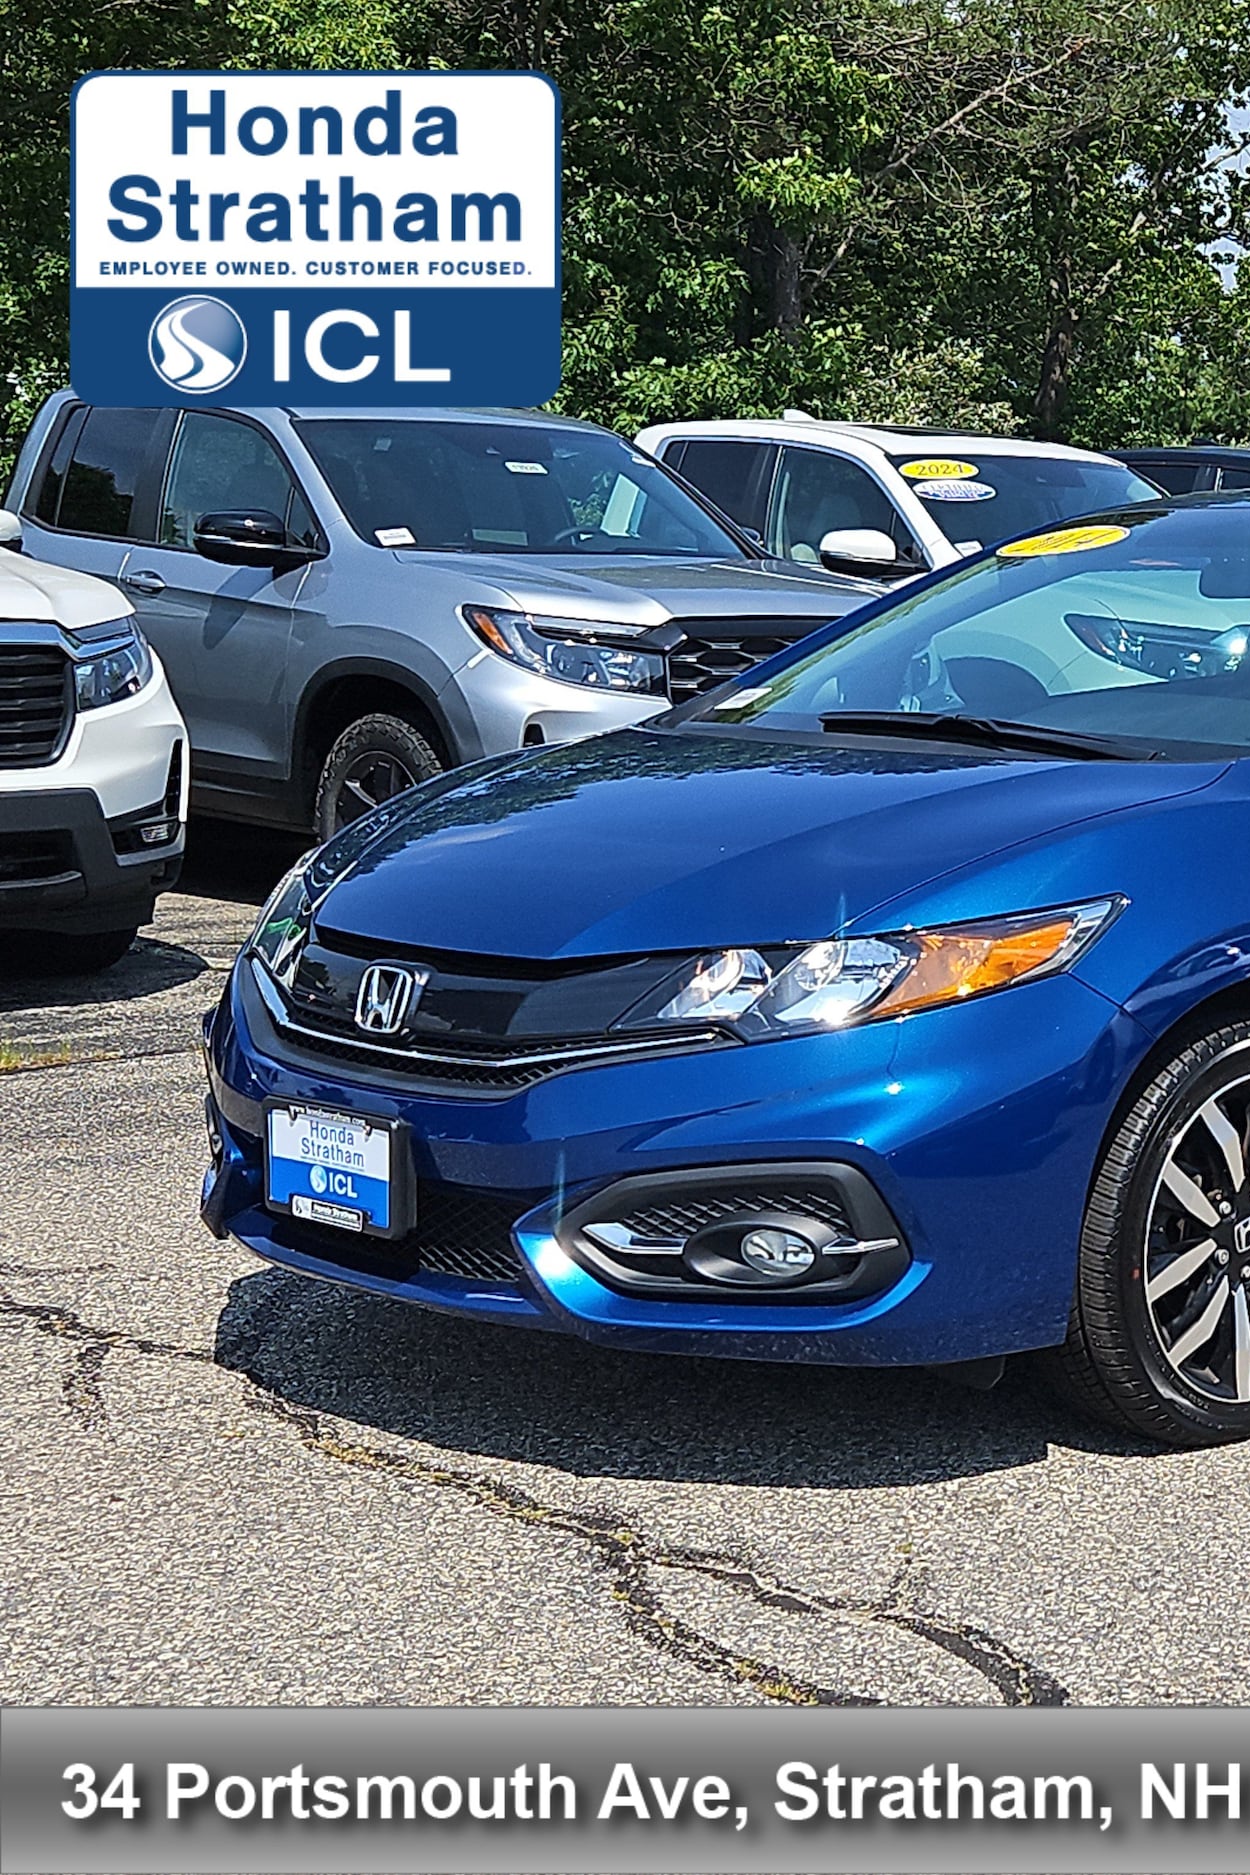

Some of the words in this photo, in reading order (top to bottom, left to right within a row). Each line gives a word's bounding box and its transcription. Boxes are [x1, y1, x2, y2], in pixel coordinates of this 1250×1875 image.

[915, 463, 964, 476] 2024
[309, 1119, 354, 1146] Honda
[301, 1137, 365, 1168] Stratham
[328, 1171, 358, 1199] ICL
